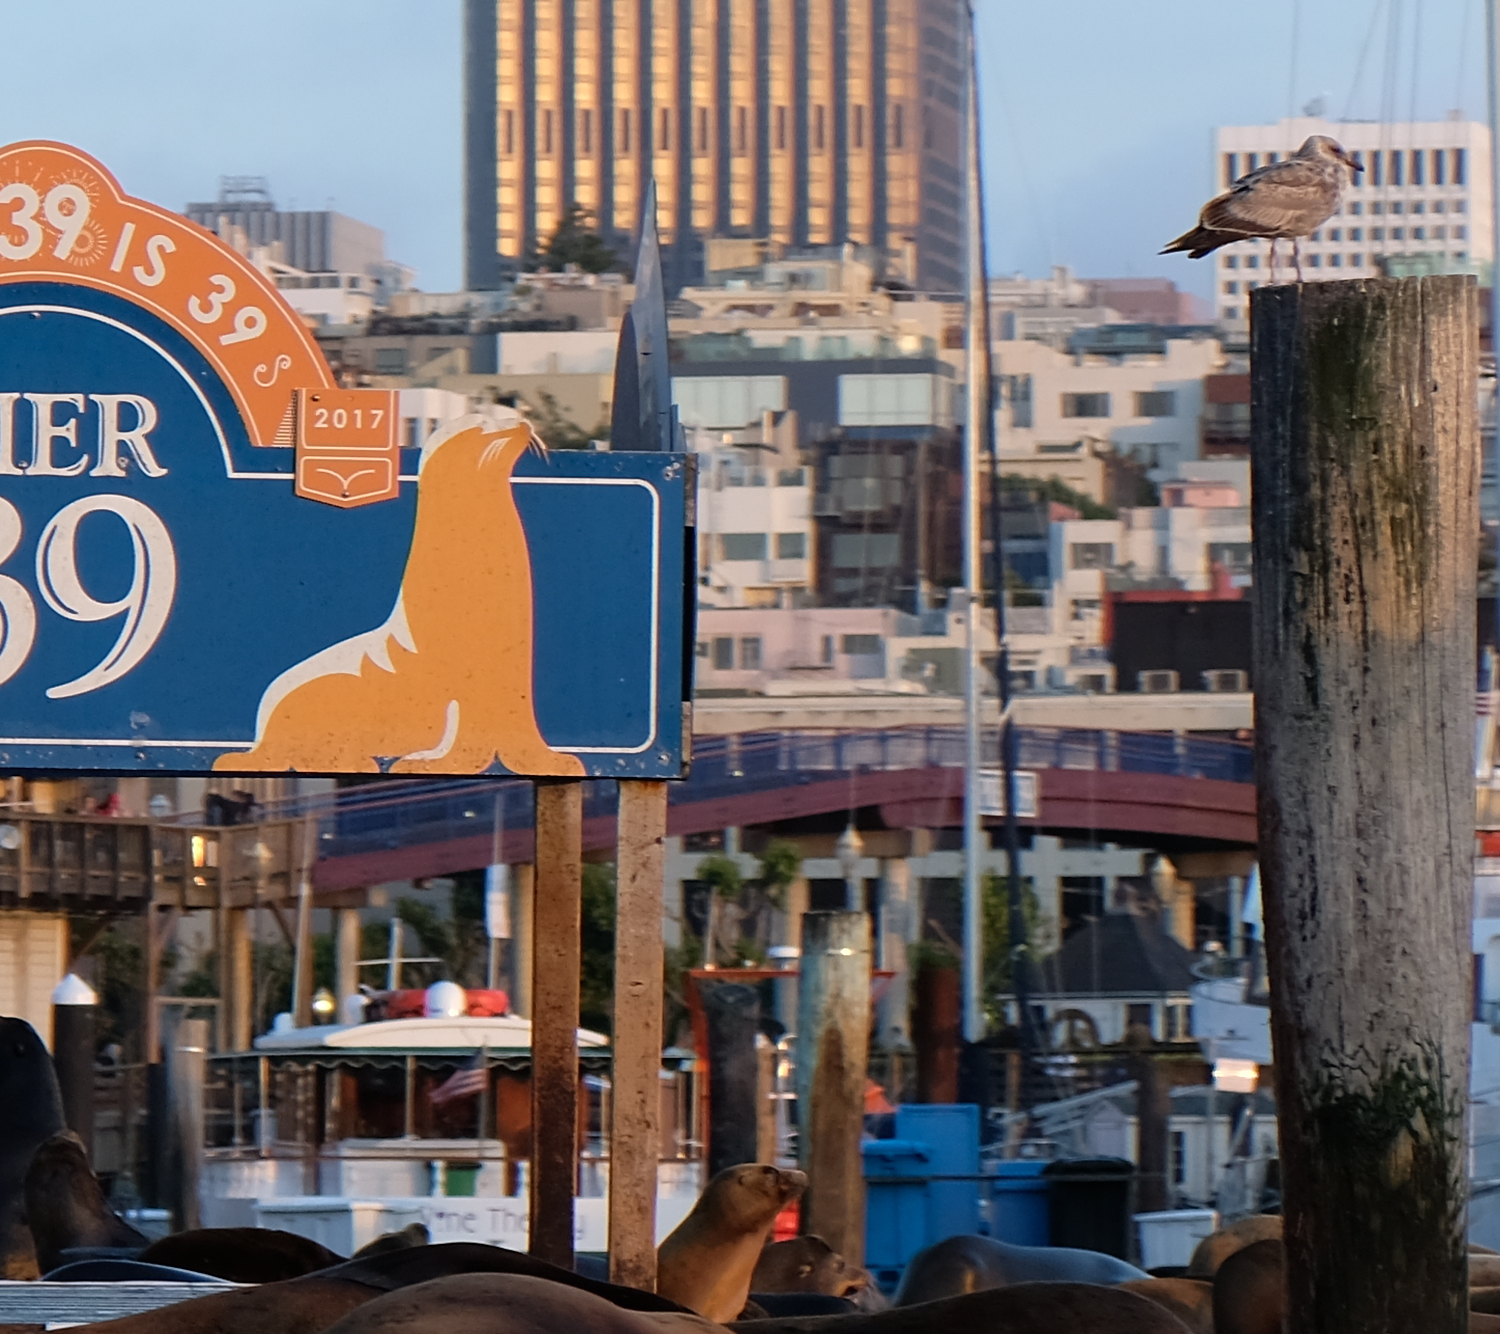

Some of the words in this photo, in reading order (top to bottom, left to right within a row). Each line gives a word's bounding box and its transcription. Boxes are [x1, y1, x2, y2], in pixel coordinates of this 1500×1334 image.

[109, 222, 177, 287] IS
[187, 273, 268, 346] 39
[313, 407, 384, 431] 2017
